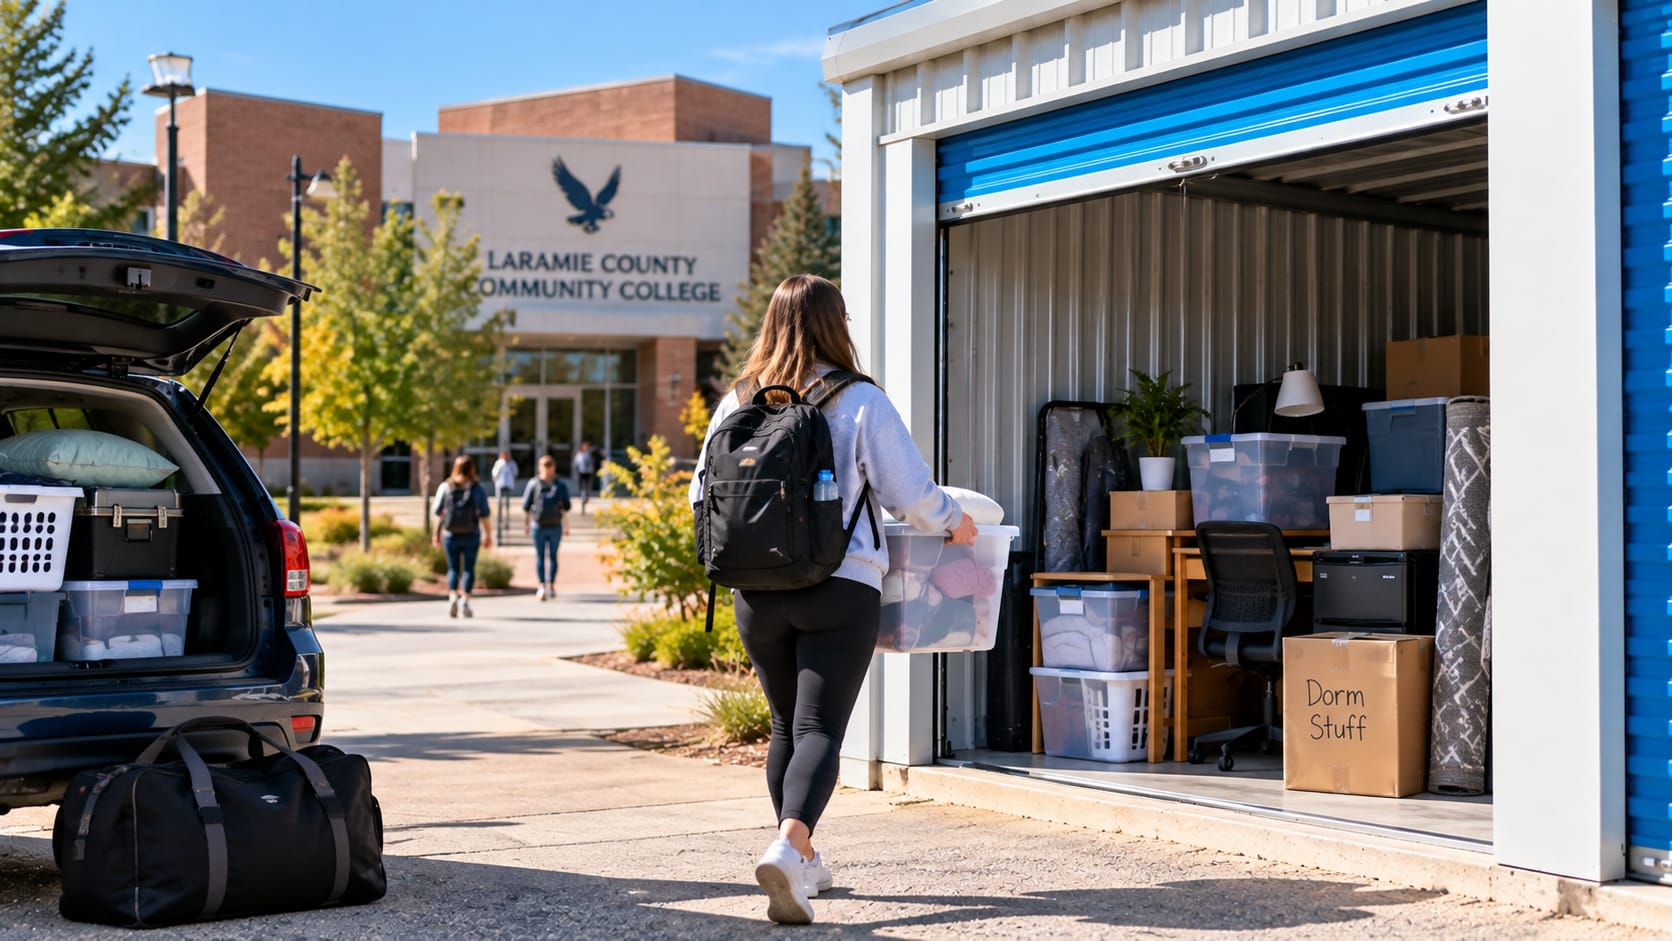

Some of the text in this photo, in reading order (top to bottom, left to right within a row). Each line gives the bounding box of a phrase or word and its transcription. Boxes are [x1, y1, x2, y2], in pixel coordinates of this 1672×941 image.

[487, 250, 698, 275] LARAMIE COUNTY
[619, 280, 721, 302] COLLEGE
[1306, 678, 1365, 707] Dorm
[1310, 713, 1367, 741] Stuff
